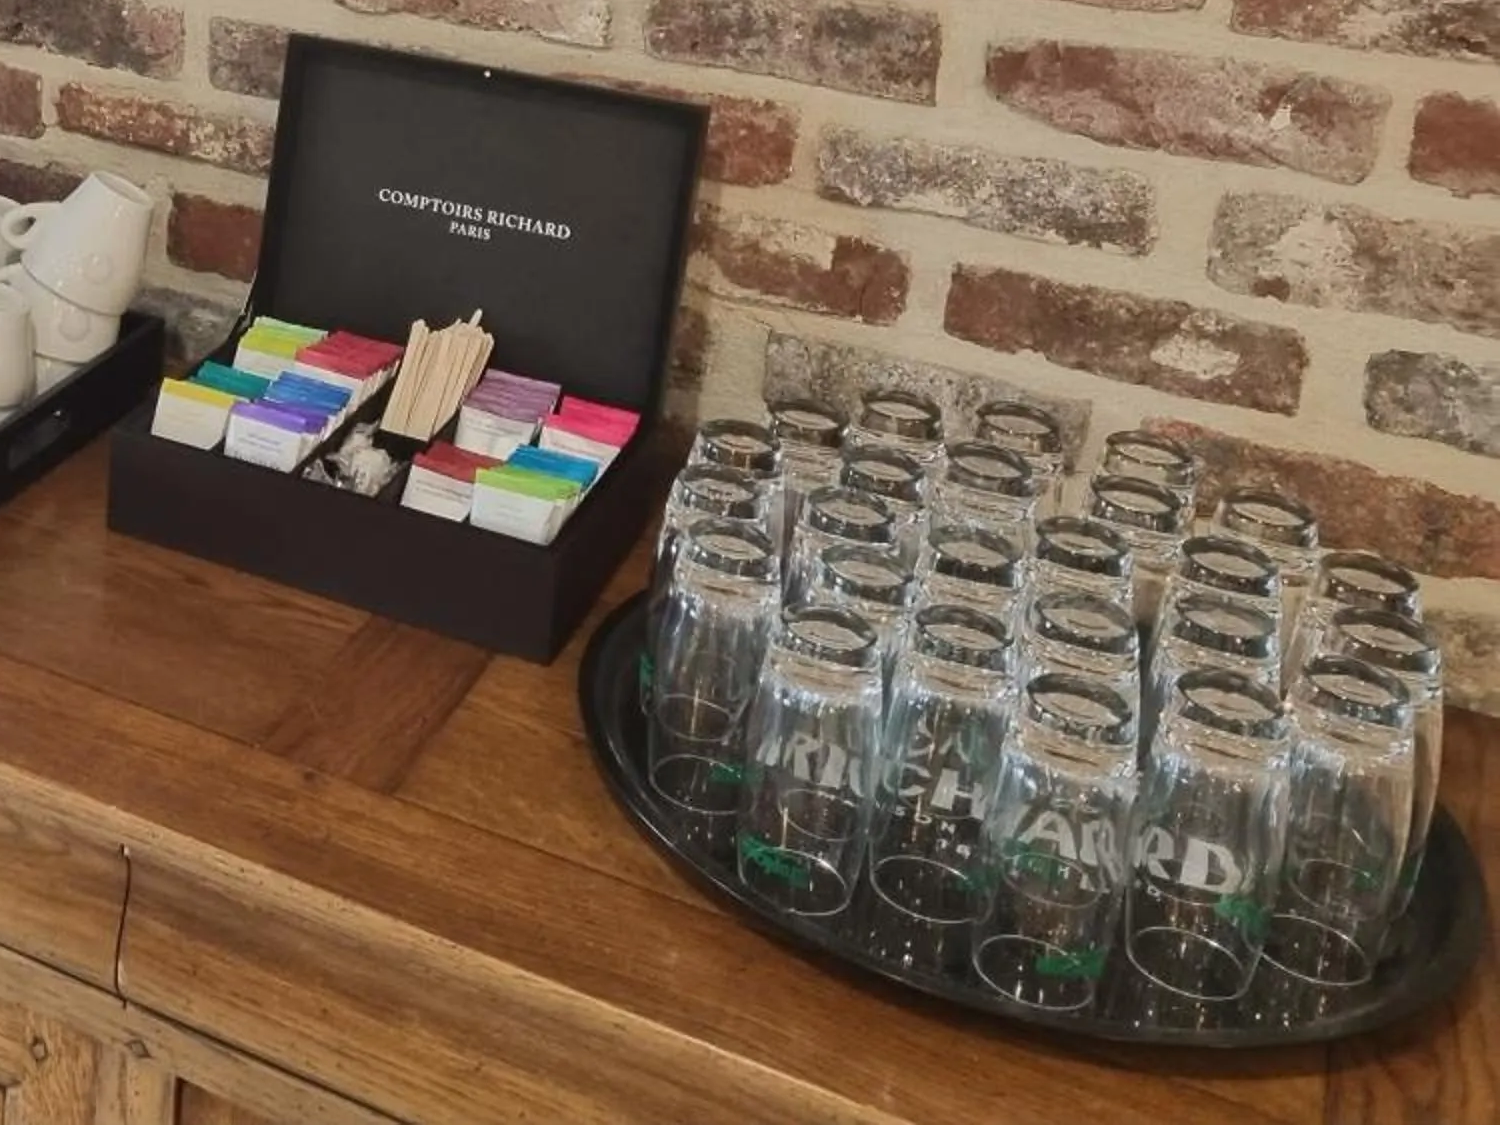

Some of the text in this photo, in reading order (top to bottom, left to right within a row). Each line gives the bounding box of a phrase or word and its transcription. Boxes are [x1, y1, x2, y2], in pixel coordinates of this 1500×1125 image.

[378, 187, 571, 240] COMPTOIRS RICHARD
[449, 221, 492, 241] PARIS
